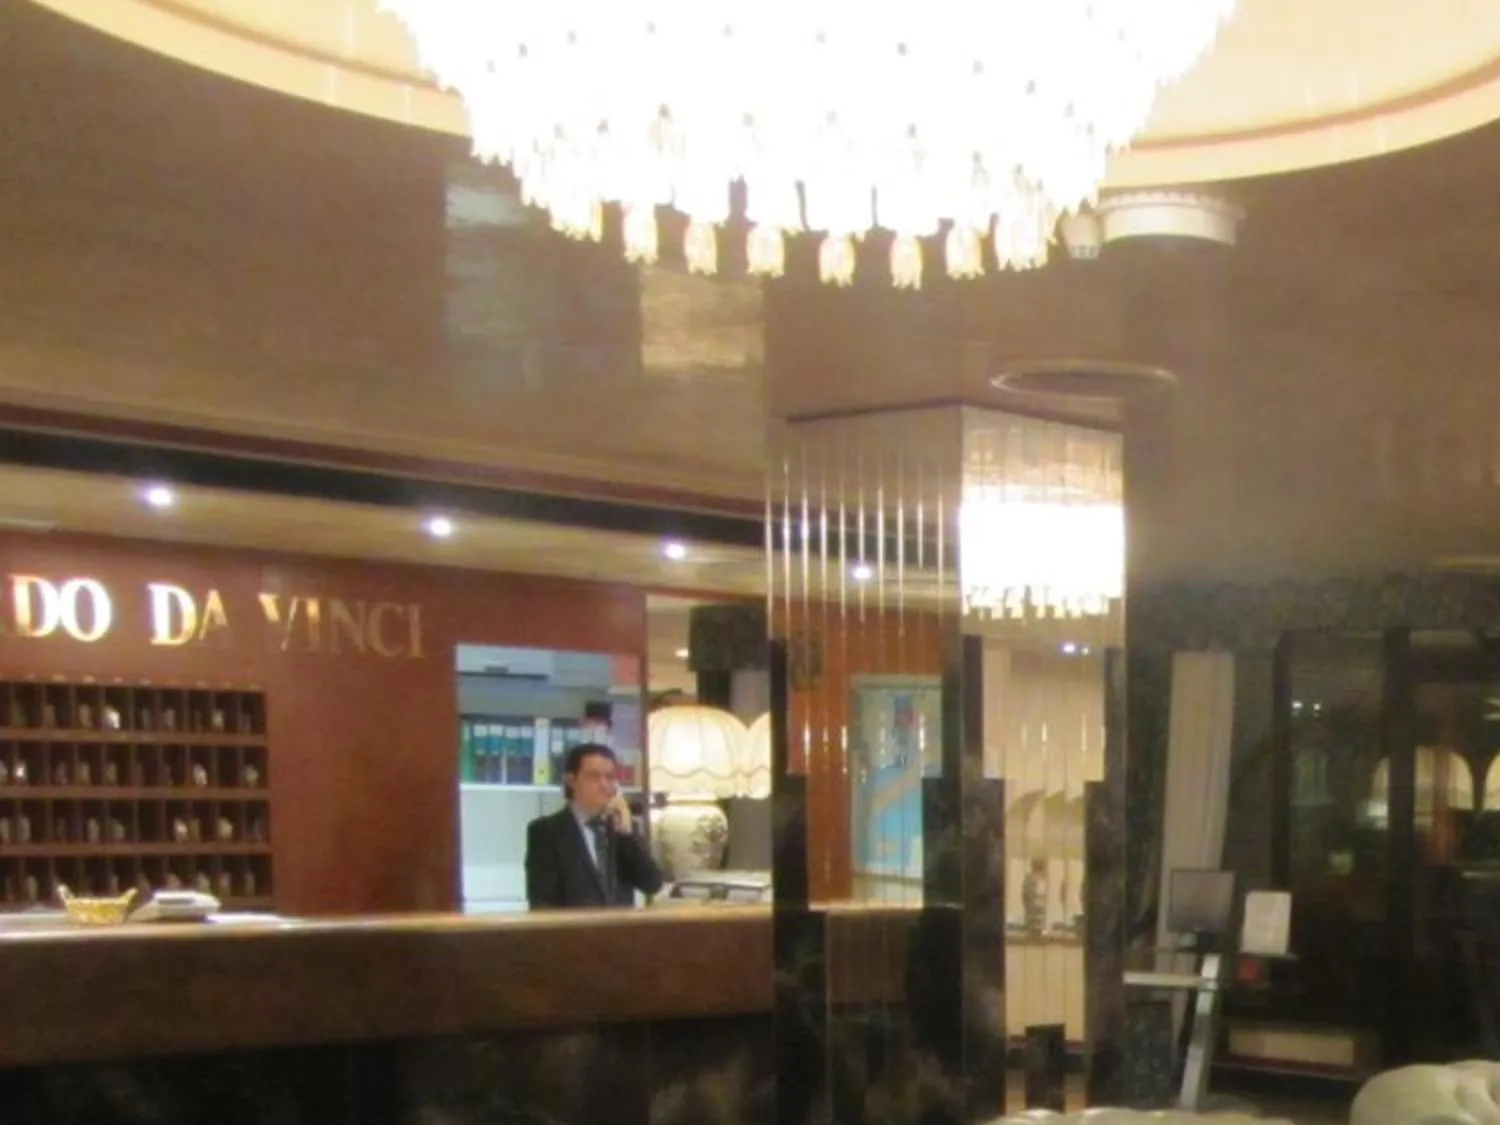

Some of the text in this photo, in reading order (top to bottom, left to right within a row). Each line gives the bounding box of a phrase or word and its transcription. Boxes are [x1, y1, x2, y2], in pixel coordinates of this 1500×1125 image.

[10, 573, 427, 660] DO DA VINCI
